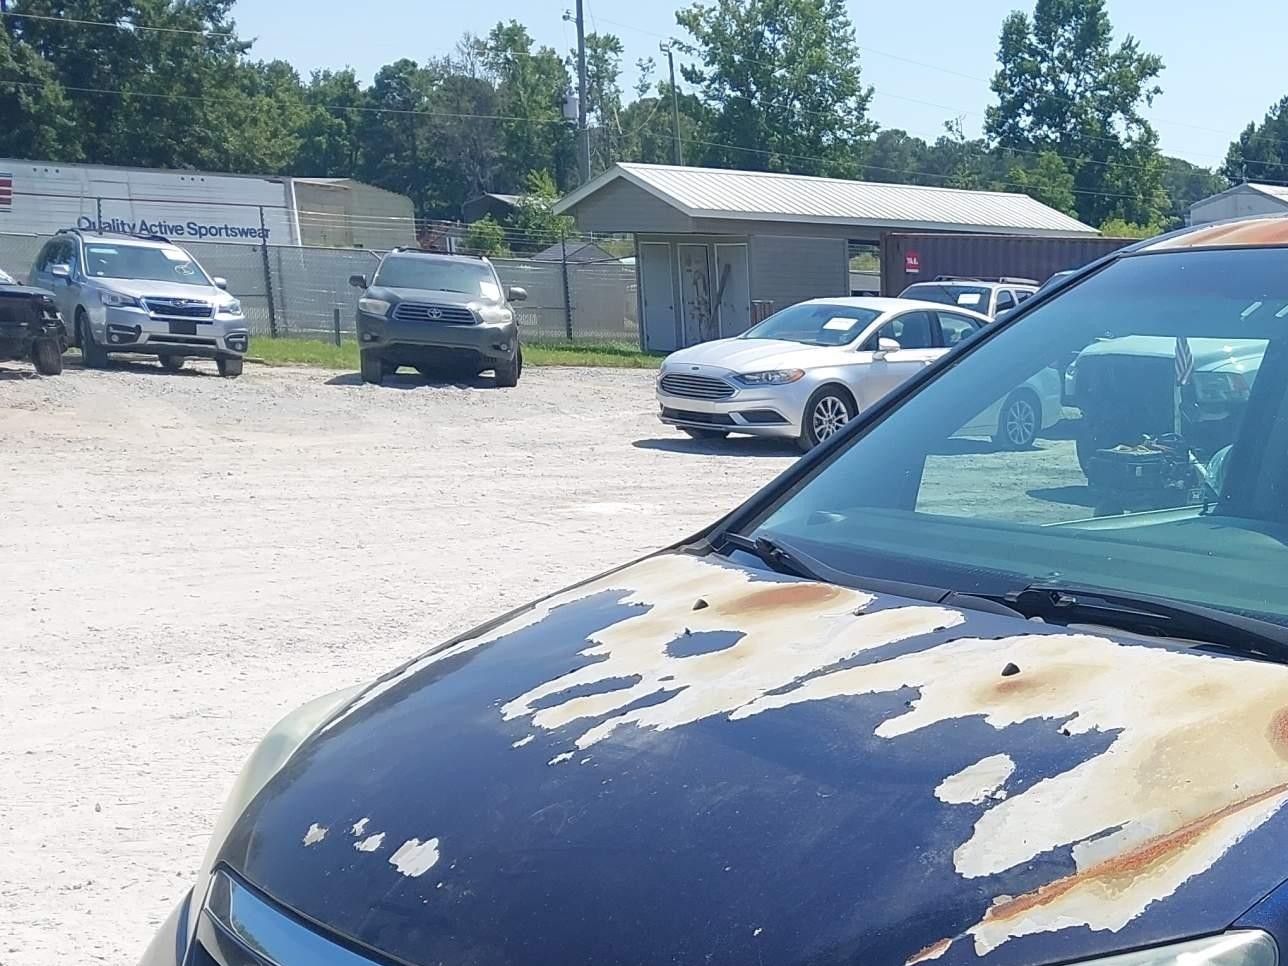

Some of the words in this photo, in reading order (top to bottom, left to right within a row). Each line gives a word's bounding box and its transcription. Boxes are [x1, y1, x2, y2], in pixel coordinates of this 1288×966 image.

[77, 216, 136, 235] Quality
[139, 219, 184, 236] Active
[186, 221, 271, 239] Sportswear
